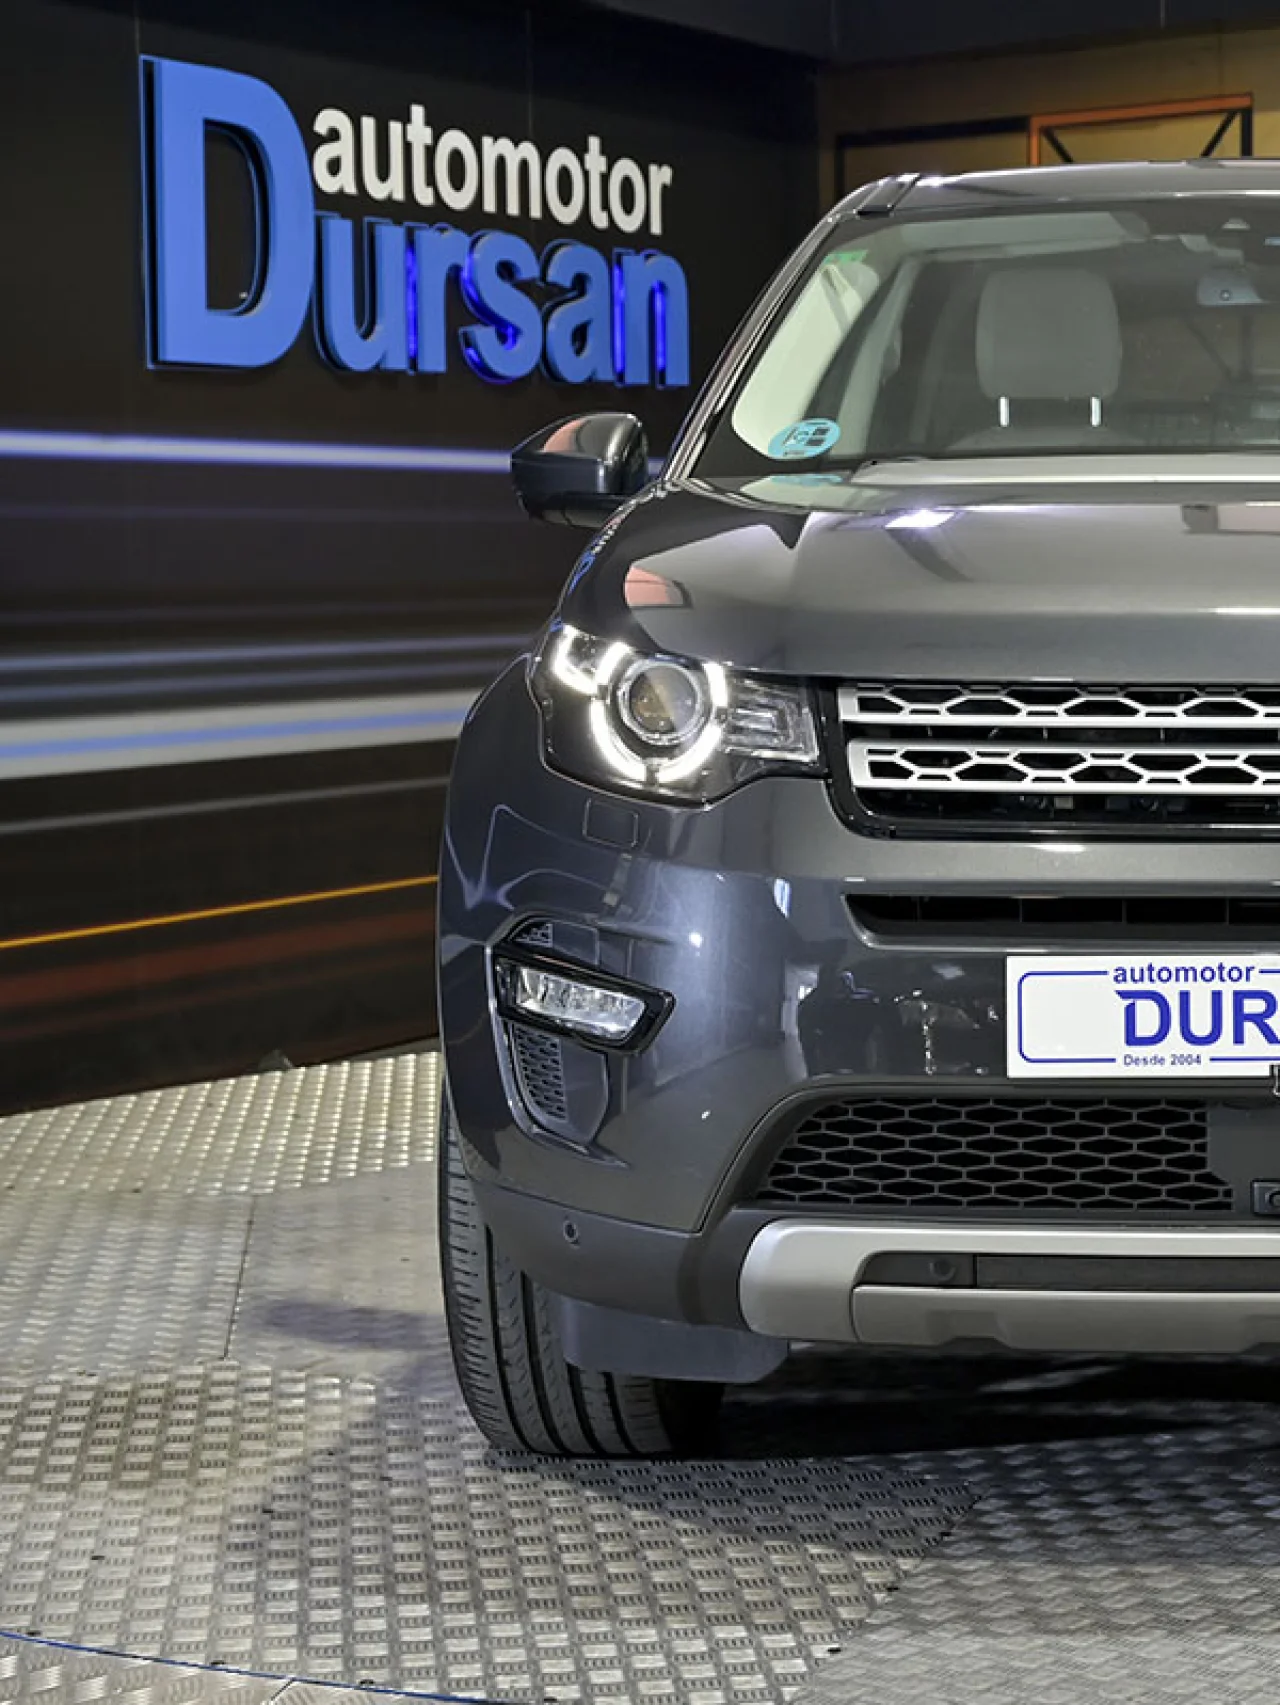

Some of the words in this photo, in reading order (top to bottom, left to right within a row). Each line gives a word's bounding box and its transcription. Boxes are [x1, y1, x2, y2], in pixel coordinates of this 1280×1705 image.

[311, 104, 673, 235] automotor
[140, 54, 690, 388] Dursan
[1112, 961, 1256, 984] automotor
[1123, 1053, 1166, 1067] Desde
[1170, 1053, 1202, 1066] 2004
